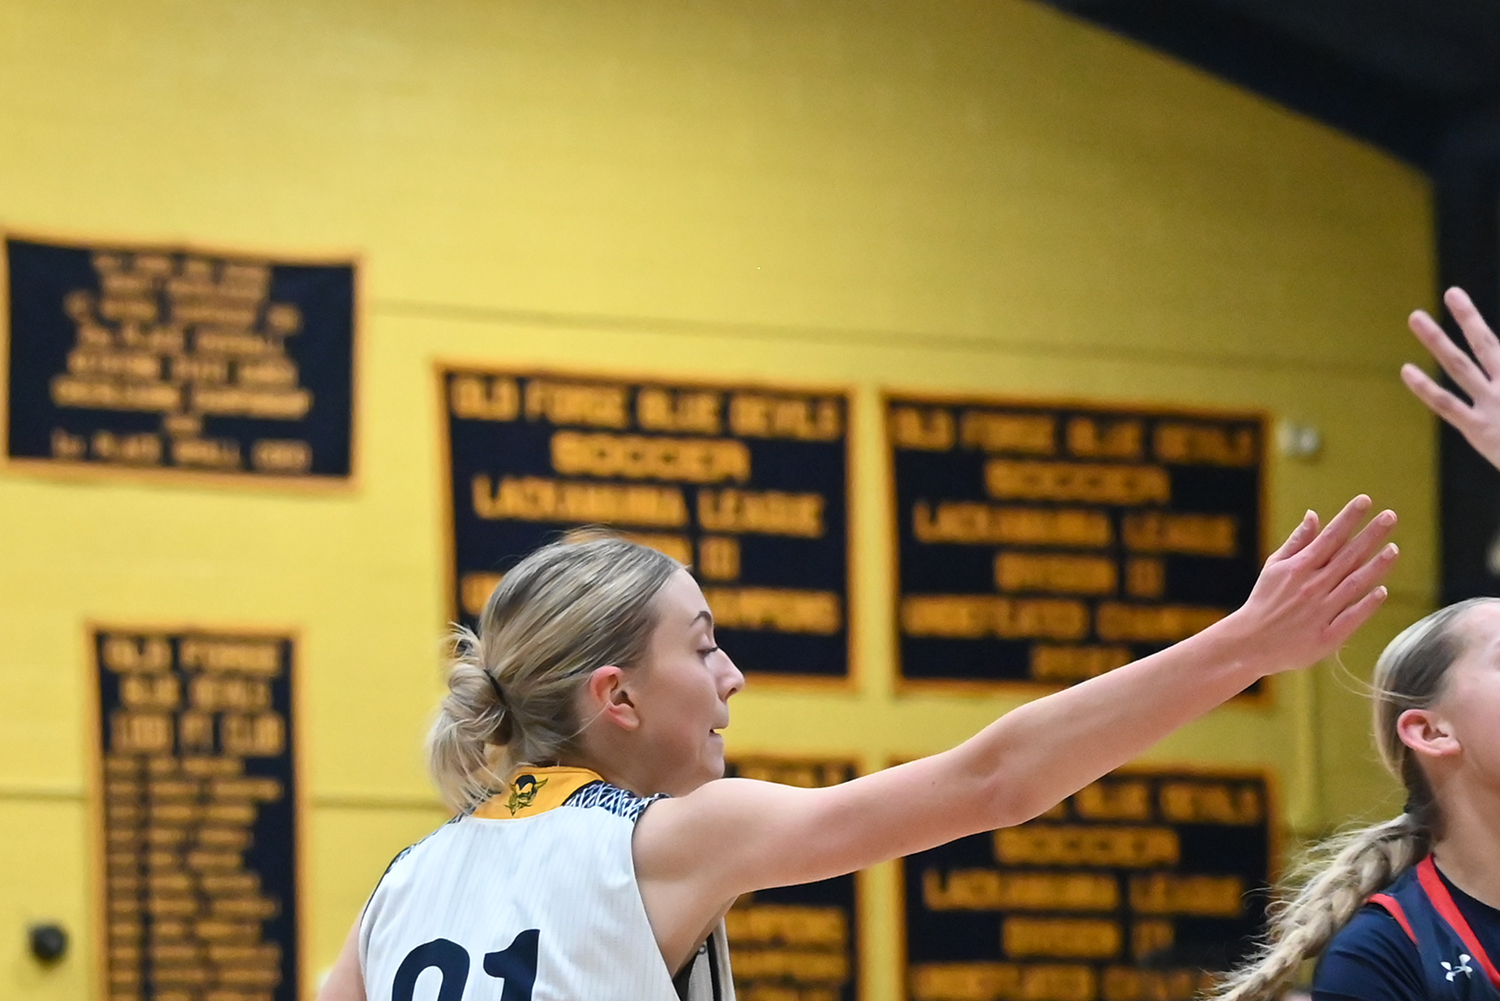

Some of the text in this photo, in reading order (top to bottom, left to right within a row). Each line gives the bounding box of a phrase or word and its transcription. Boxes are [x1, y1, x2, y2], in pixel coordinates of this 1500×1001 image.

[451, 377, 842, 441] OLD FORGE BLUE DEVILS
[550, 430, 751, 483] SOCCER
[892, 407, 1253, 467] OLD FORGE BLUE DEVILS
[472, 474, 823, 538] LACKAWANNA LEAGUE
[985, 459, 1170, 504] SOCCER
[1122, 513, 1235, 557] LEAGUE
[992, 826, 1179, 867] SOCCER
